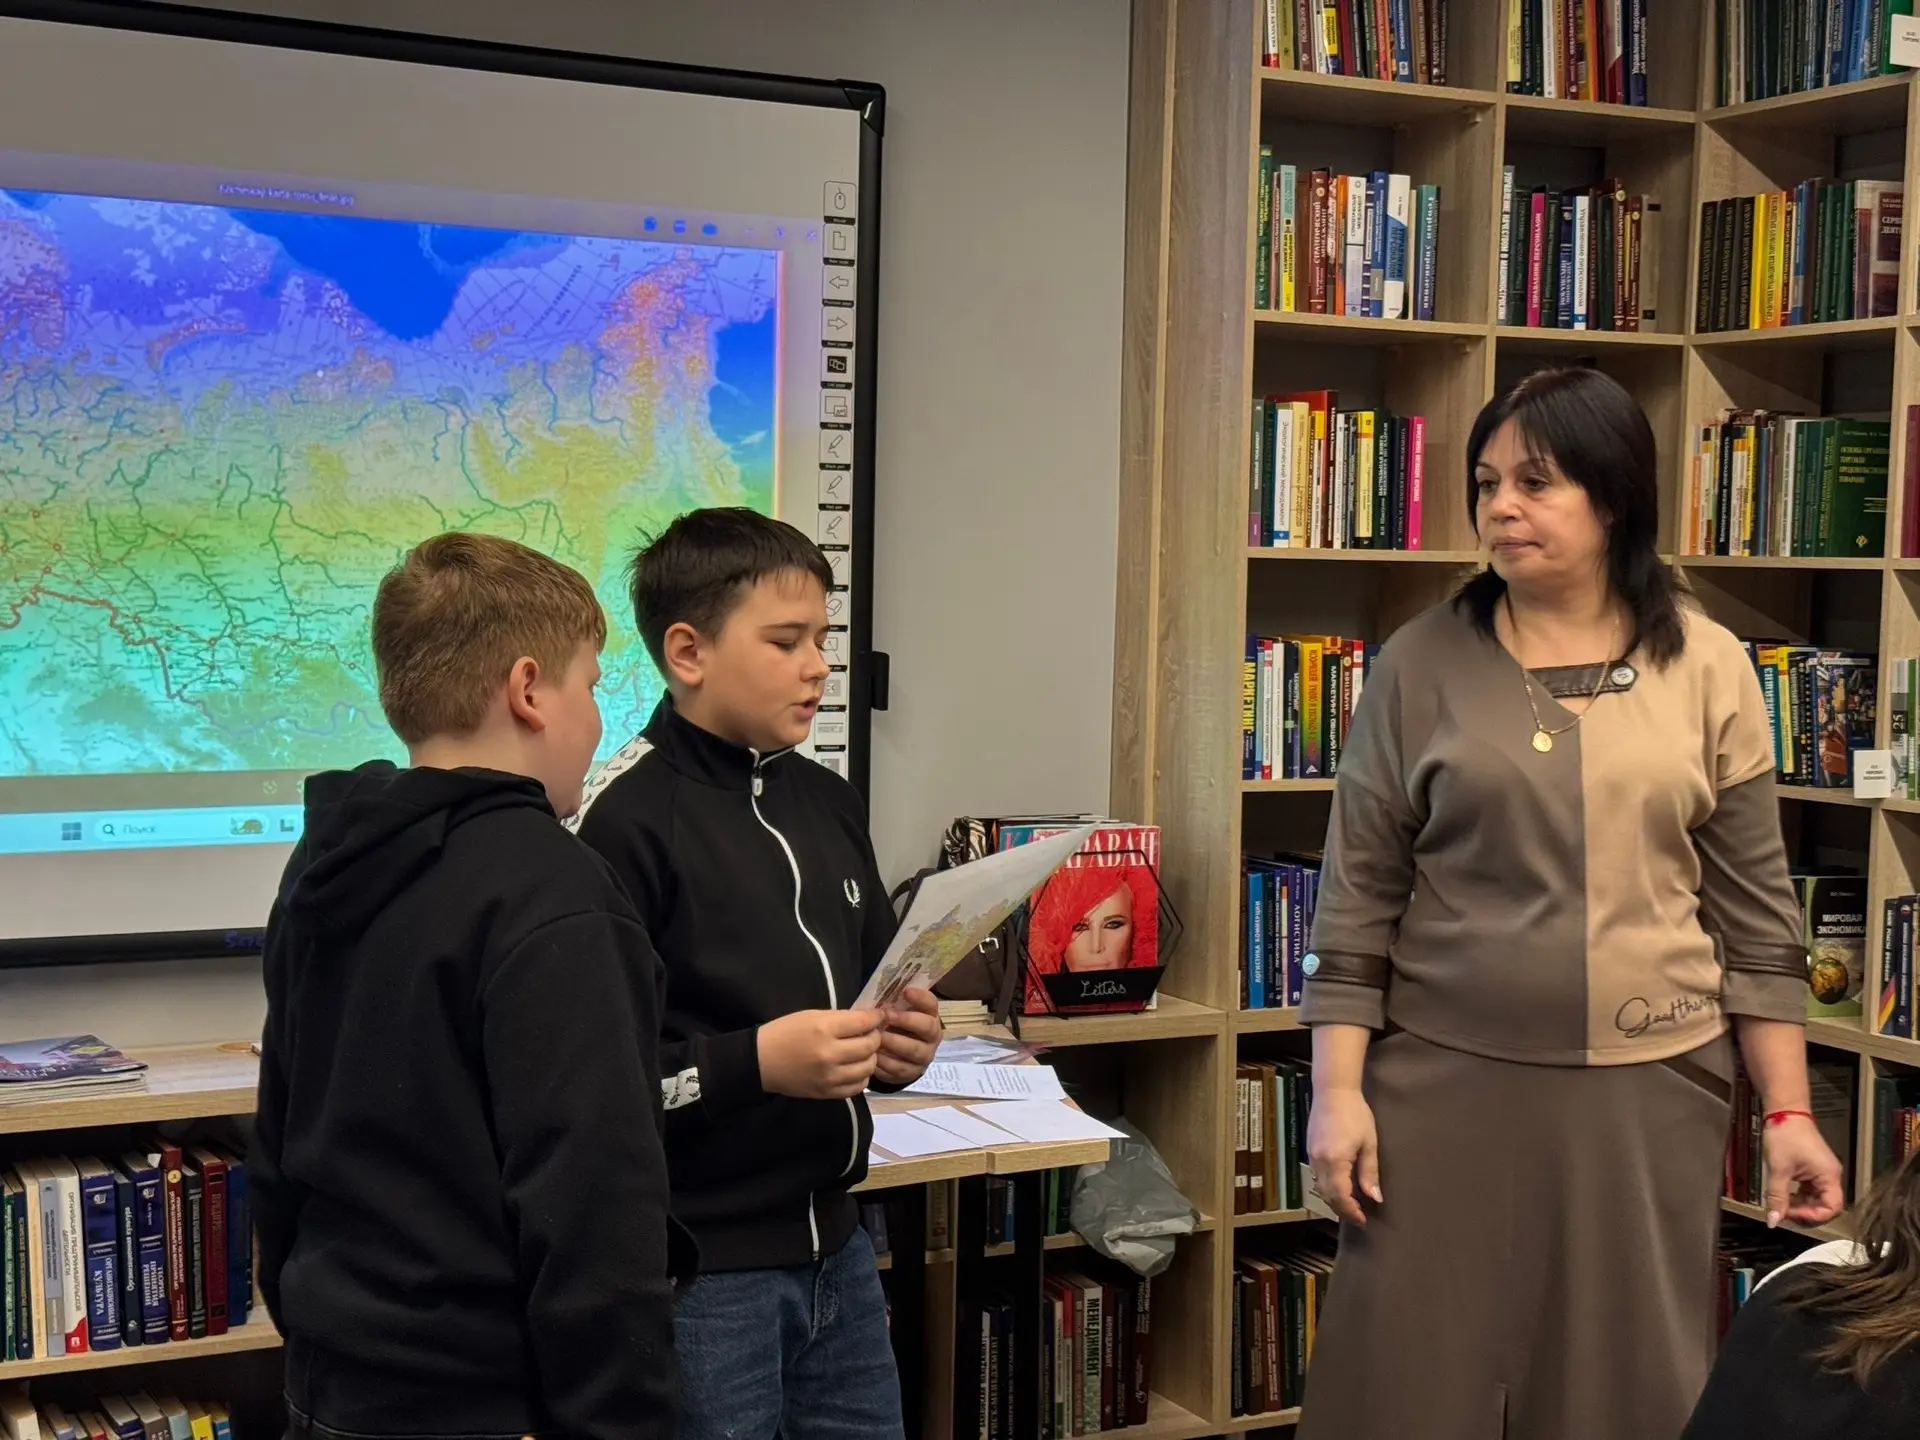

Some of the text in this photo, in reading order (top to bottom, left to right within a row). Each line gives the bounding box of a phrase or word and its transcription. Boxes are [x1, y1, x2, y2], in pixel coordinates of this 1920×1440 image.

[1632, 33, 1641, 74] Управление
[1503, 172, 1513, 213] УПРАВЛЕНИЕ
[1312, 202, 1321, 264] СТРАТЕГИЧЕСКИЙ
[1388, 227, 1397, 278] ПЕРСОНАЛОМ
[1396, 227, 1405, 278] УПРАВЛЕНИЕ
[1577, 208, 1587, 307] Управление персоналом
[1531, 213, 1542, 309] УПРАВЛЕНИЕ ПЕРСОНАЛОМ
[1278, 421, 1289, 526] Экологический менеджмент
[1892, 714, 1904, 730] 25
[1329, 750, 1337, 773] КУРС
[122, 823, 157, 835] Поиск
[1254, 900, 1262, 984] ЛОГИСТИКА КОММЕРЦИИ
[1293, 904, 1301, 964] ЛОГИСТИКА
[1822, 913, 1863, 923] МИРОВАЯ
[1080, 979, 1127, 998] Letters
[62, 1229, 71, 1276] ДЕЯТЕЛЬНОСТИ
[68, 1192, 81, 1311] ОРГАНИЗАЦИЯ ПРЕДПРИНИМАТЕЛЬСКОЙ
[123, 1206, 136, 1292] Организационная культура
[94, 1270, 105, 1316] КУЛЬТУРА
[104, 1257, 115, 1324] ОРГАНИЗАЦИОННАЯ
[142, 1264, 151, 1306] РЕШЕНИЙ
[150, 1261, 159, 1307] ПРИНЯТИЯ
[157, 1264, 165, 1298] ТЕОРИЯ
[1085, 1298, 1101, 1377] МЕНЕДЖМЕНТ
